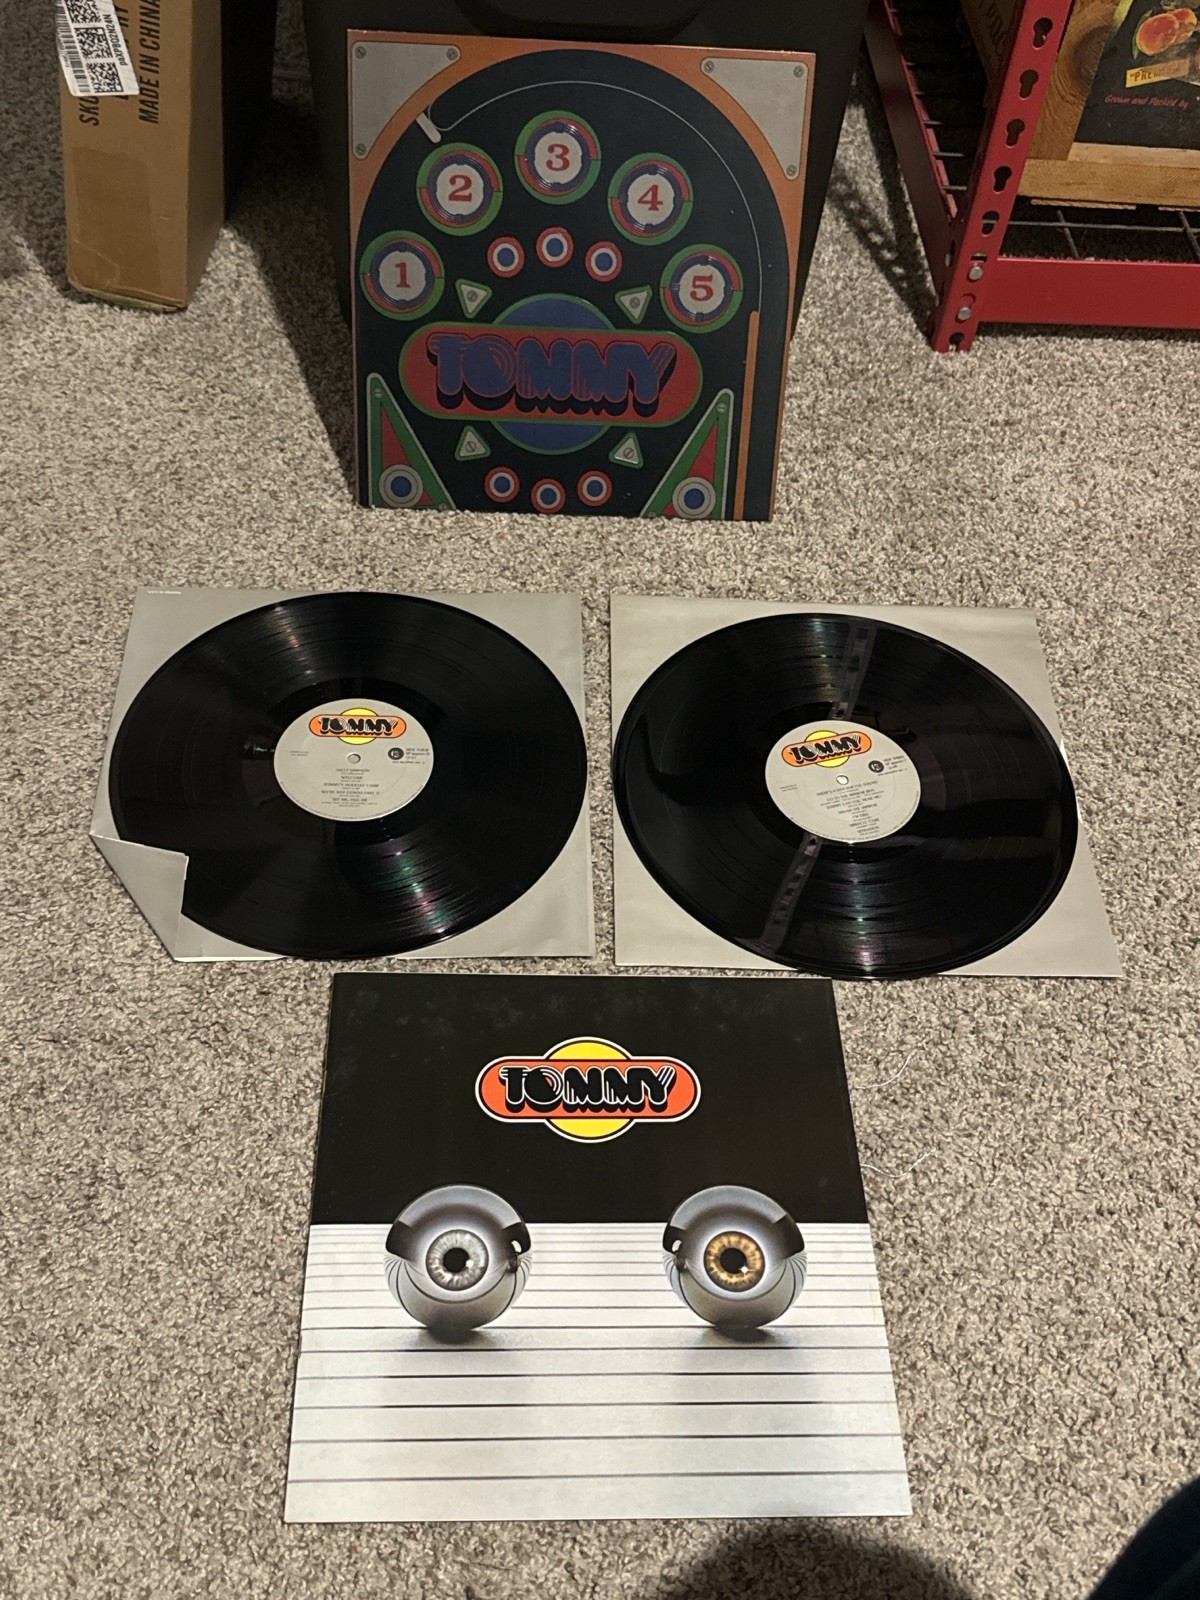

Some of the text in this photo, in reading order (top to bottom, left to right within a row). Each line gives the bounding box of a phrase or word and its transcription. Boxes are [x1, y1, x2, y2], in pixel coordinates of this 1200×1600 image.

[138, 0, 160, 124] MADE IN CHINA
[546, 143, 570, 171] 3
[448, 174, 472, 202] 2
[637, 184, 664, 211] 4
[394, 262, 411, 289] 1
[689, 274, 714, 302] 5
[426, 332, 677, 417] TOMMY
[318, 717, 399, 735] TOMMY
[789, 734, 862, 764] TOMMY
[498, 1065, 677, 1113] TOMMY
